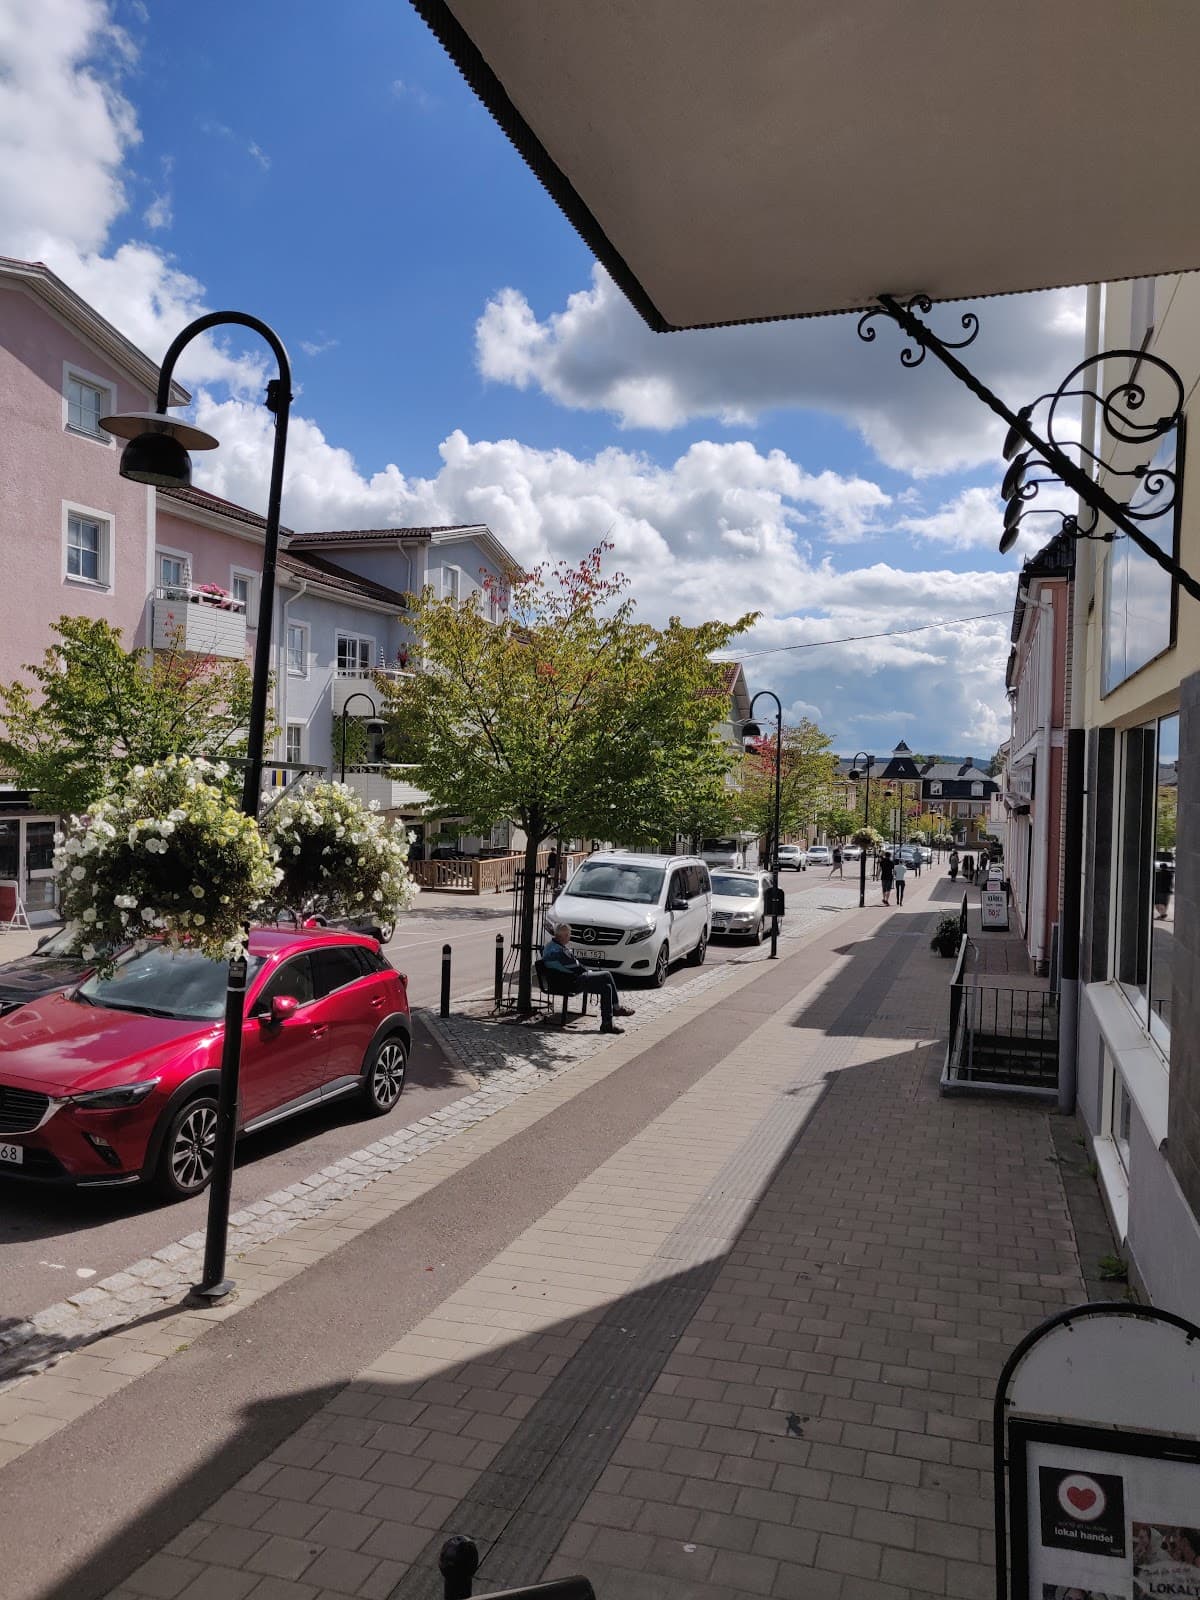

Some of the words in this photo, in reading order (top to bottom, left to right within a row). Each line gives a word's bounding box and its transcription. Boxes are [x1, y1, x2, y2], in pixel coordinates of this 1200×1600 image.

[1, 1145, 17, 1160] 68
[1055, 1526, 1078, 1537] lokal
[1080, 1530, 1113, 1543] handel
